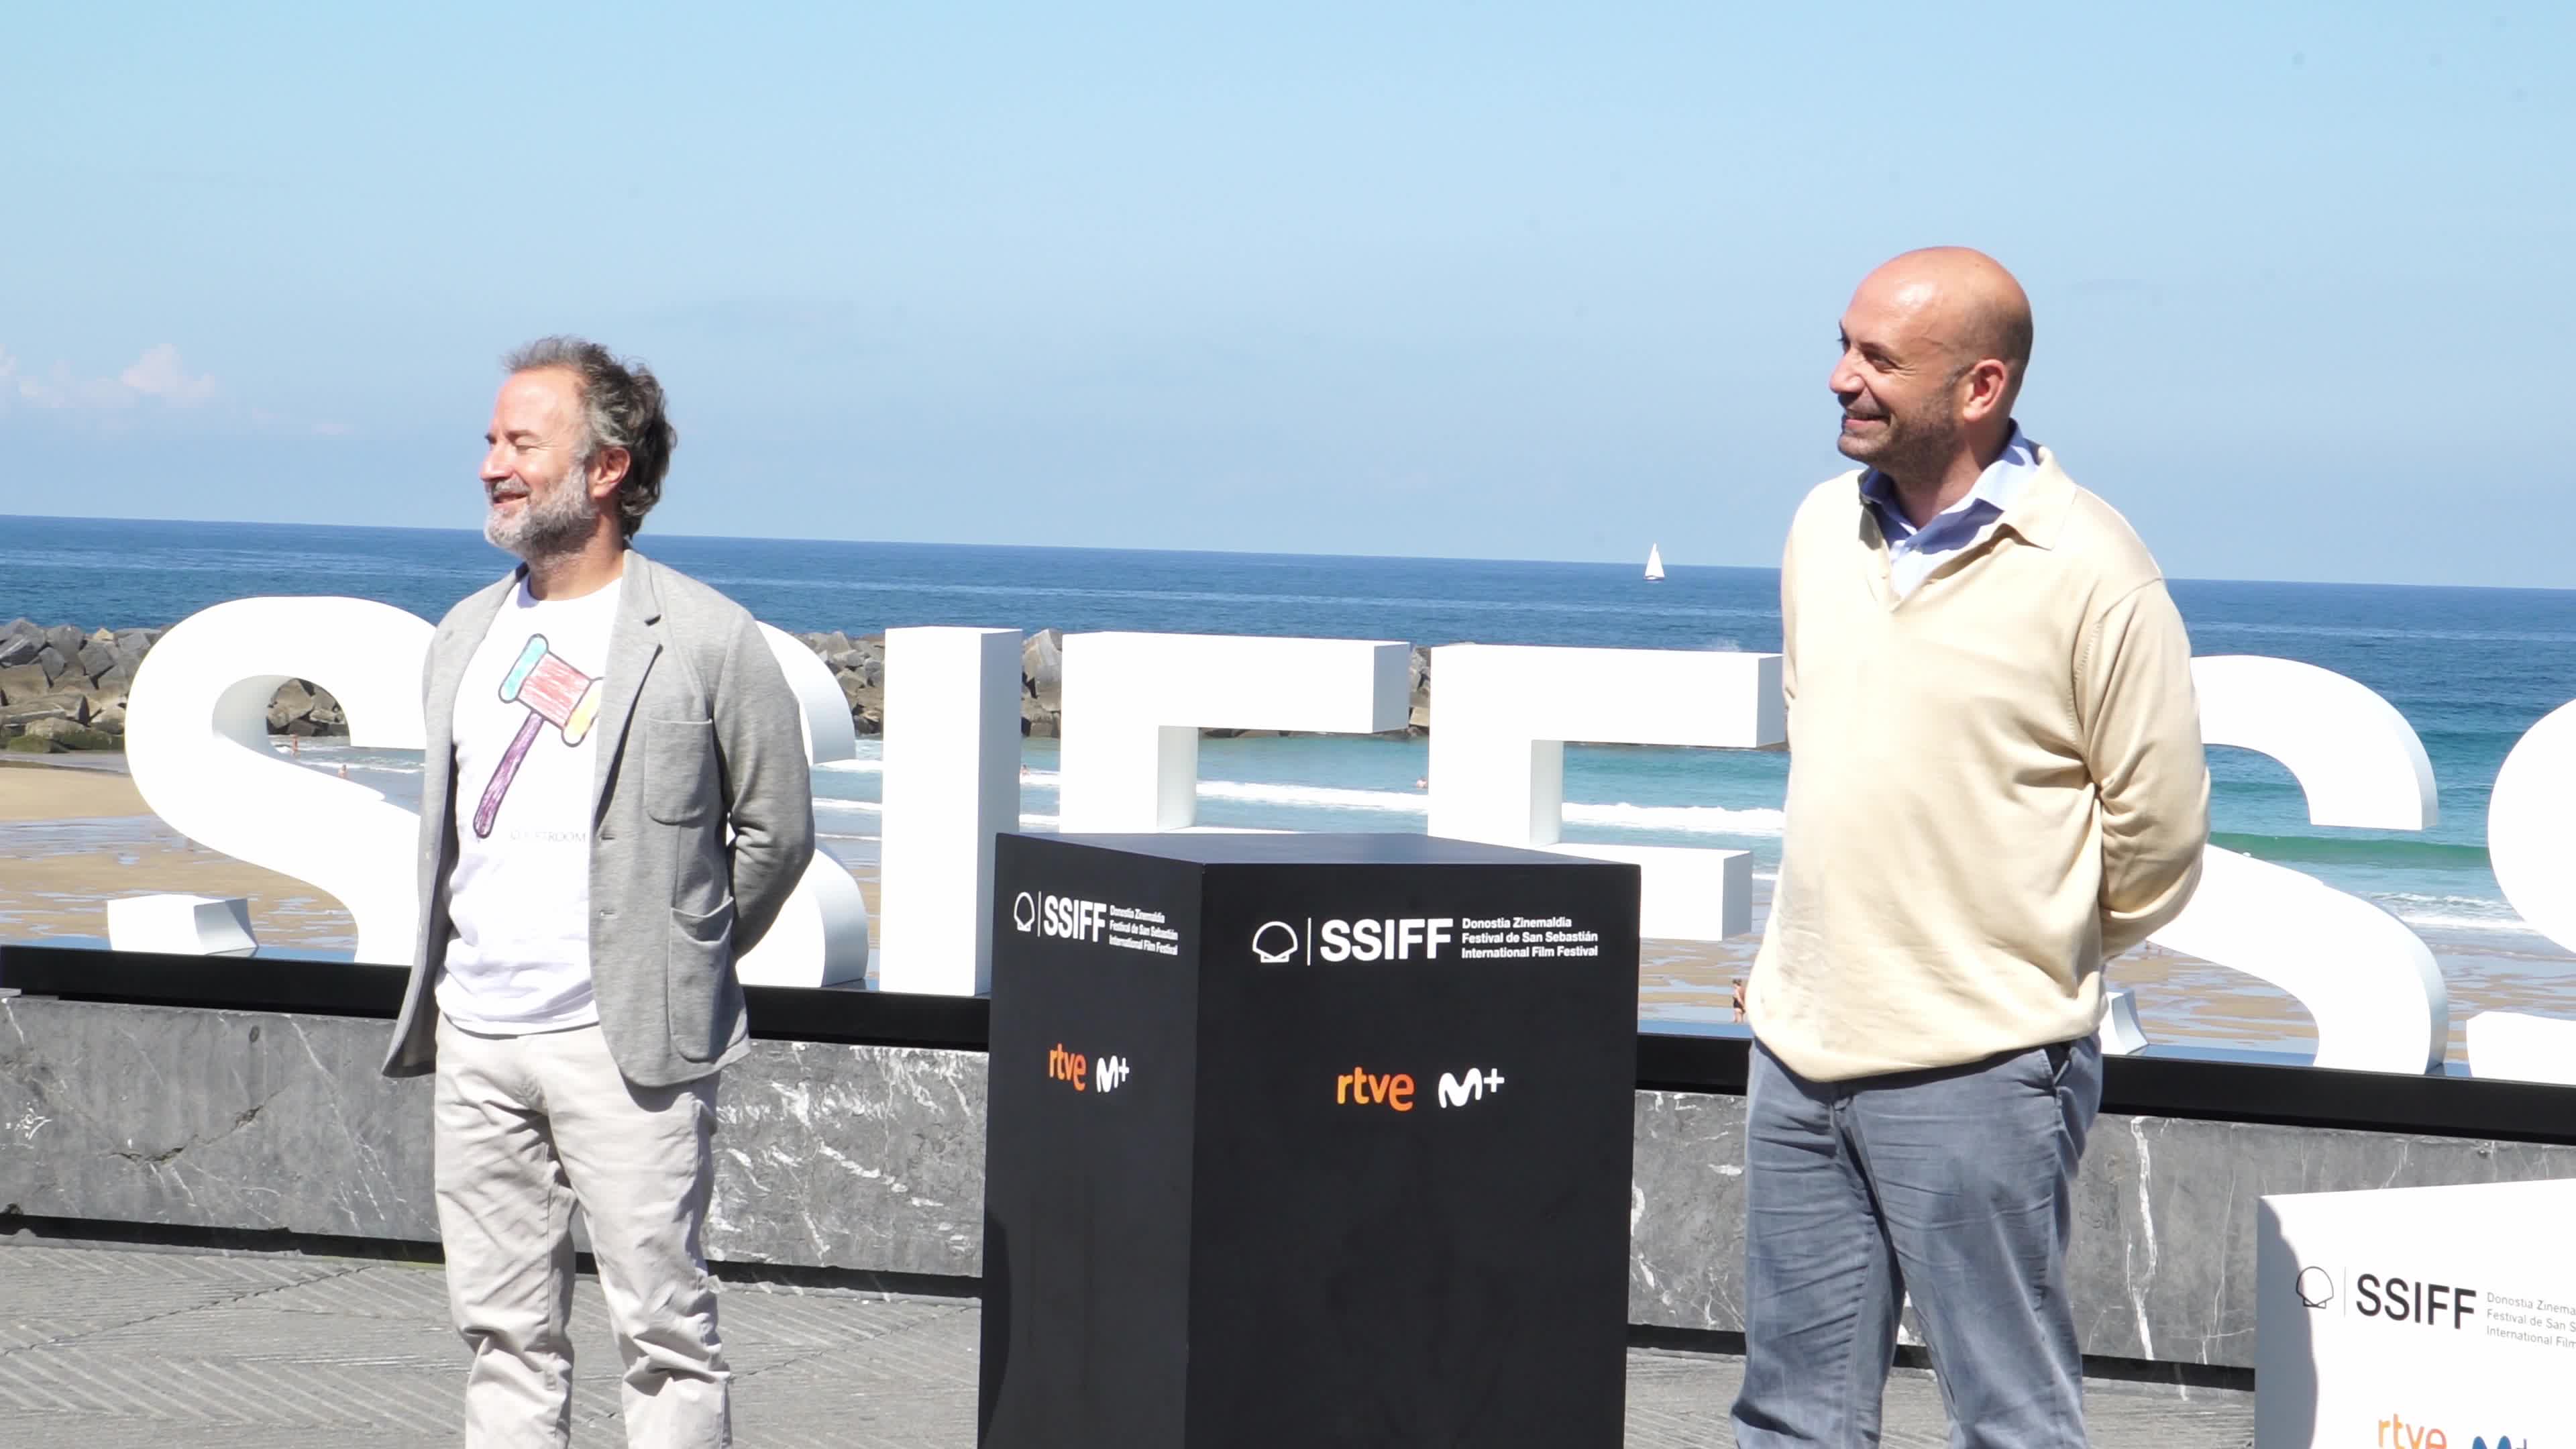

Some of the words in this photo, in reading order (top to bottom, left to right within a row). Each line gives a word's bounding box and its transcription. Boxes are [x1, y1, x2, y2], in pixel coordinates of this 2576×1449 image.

[1043, 895, 1107, 943] SSIFF
[1110, 920, 1131, 933] Festival
[1139, 924, 1150, 936] San
[1462, 918, 1511, 928] Donostia
[1513, 916, 1572, 928] Zinemaldia
[1109, 934, 1143, 950] International
[1143, 939, 1156, 952] Film
[1156, 942, 1178, 956] Festival
[1320, 918, 1454, 962] SSIFF
[1462, 932, 1503, 944] Festival
[1505, 932, 1520, 943] de
[1522, 932, 1543, 943] San
[1545, 930, 1598, 943] Sebastián
[1461, 947, 1529, 959] International
[1532, 946, 1554, 957] Film
[1557, 945, 1598, 957] Festival
[1049, 1042, 1087, 1091] rtve
[1336, 1067, 1415, 1111] rtve
[2356, 1273, 2477, 1330] SSIFF
[2487, 1291, 2534, 1309] Donostia
[2487, 1309, 2526, 1324] Festival
[2530, 1316, 2542, 1327] de
[2546, 1318, 2566, 1332] San
[2487, 1325, 2553, 1346] International
